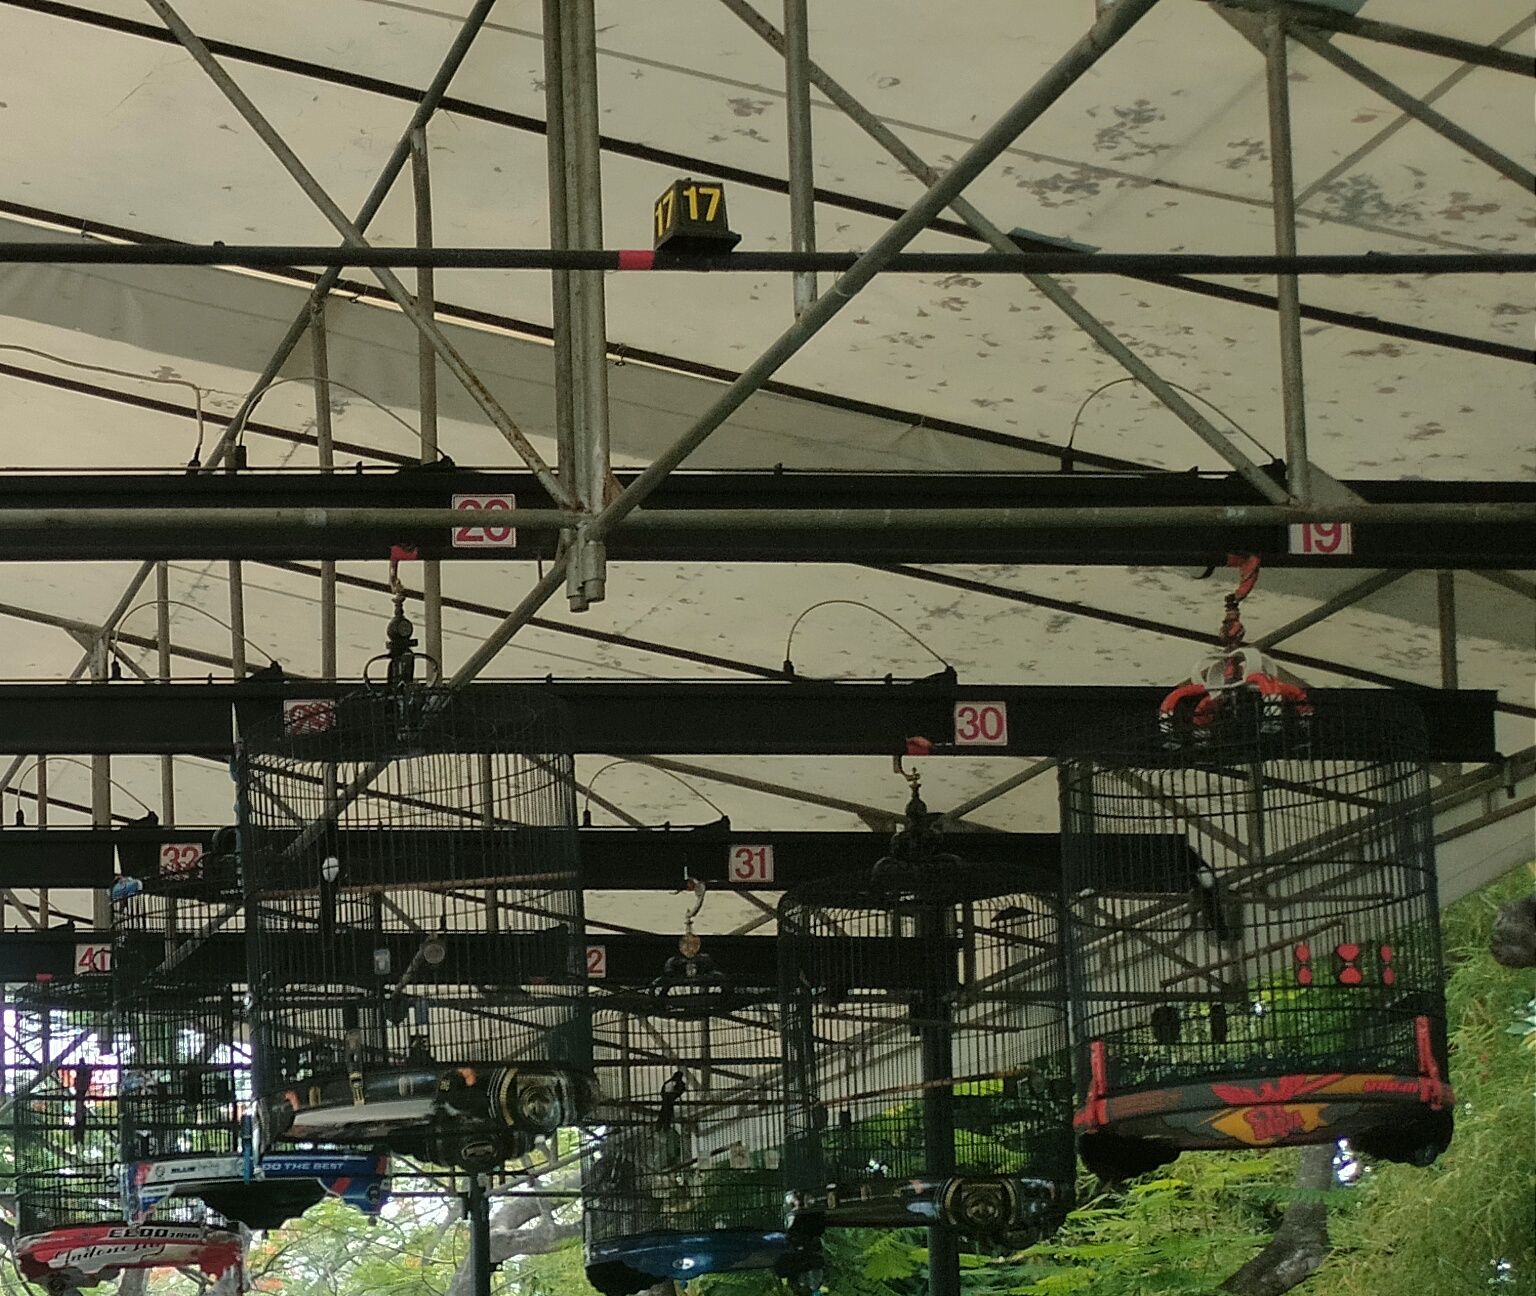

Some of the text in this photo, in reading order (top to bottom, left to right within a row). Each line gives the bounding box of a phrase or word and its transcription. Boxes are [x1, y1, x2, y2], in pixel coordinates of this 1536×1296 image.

[655, 191, 674, 237] 17
[683, 186, 721, 222] 17
[958, 706, 1005, 741] 30
[735, 847, 767, 879] 31
[312, 1163, 345, 1171] BEST
